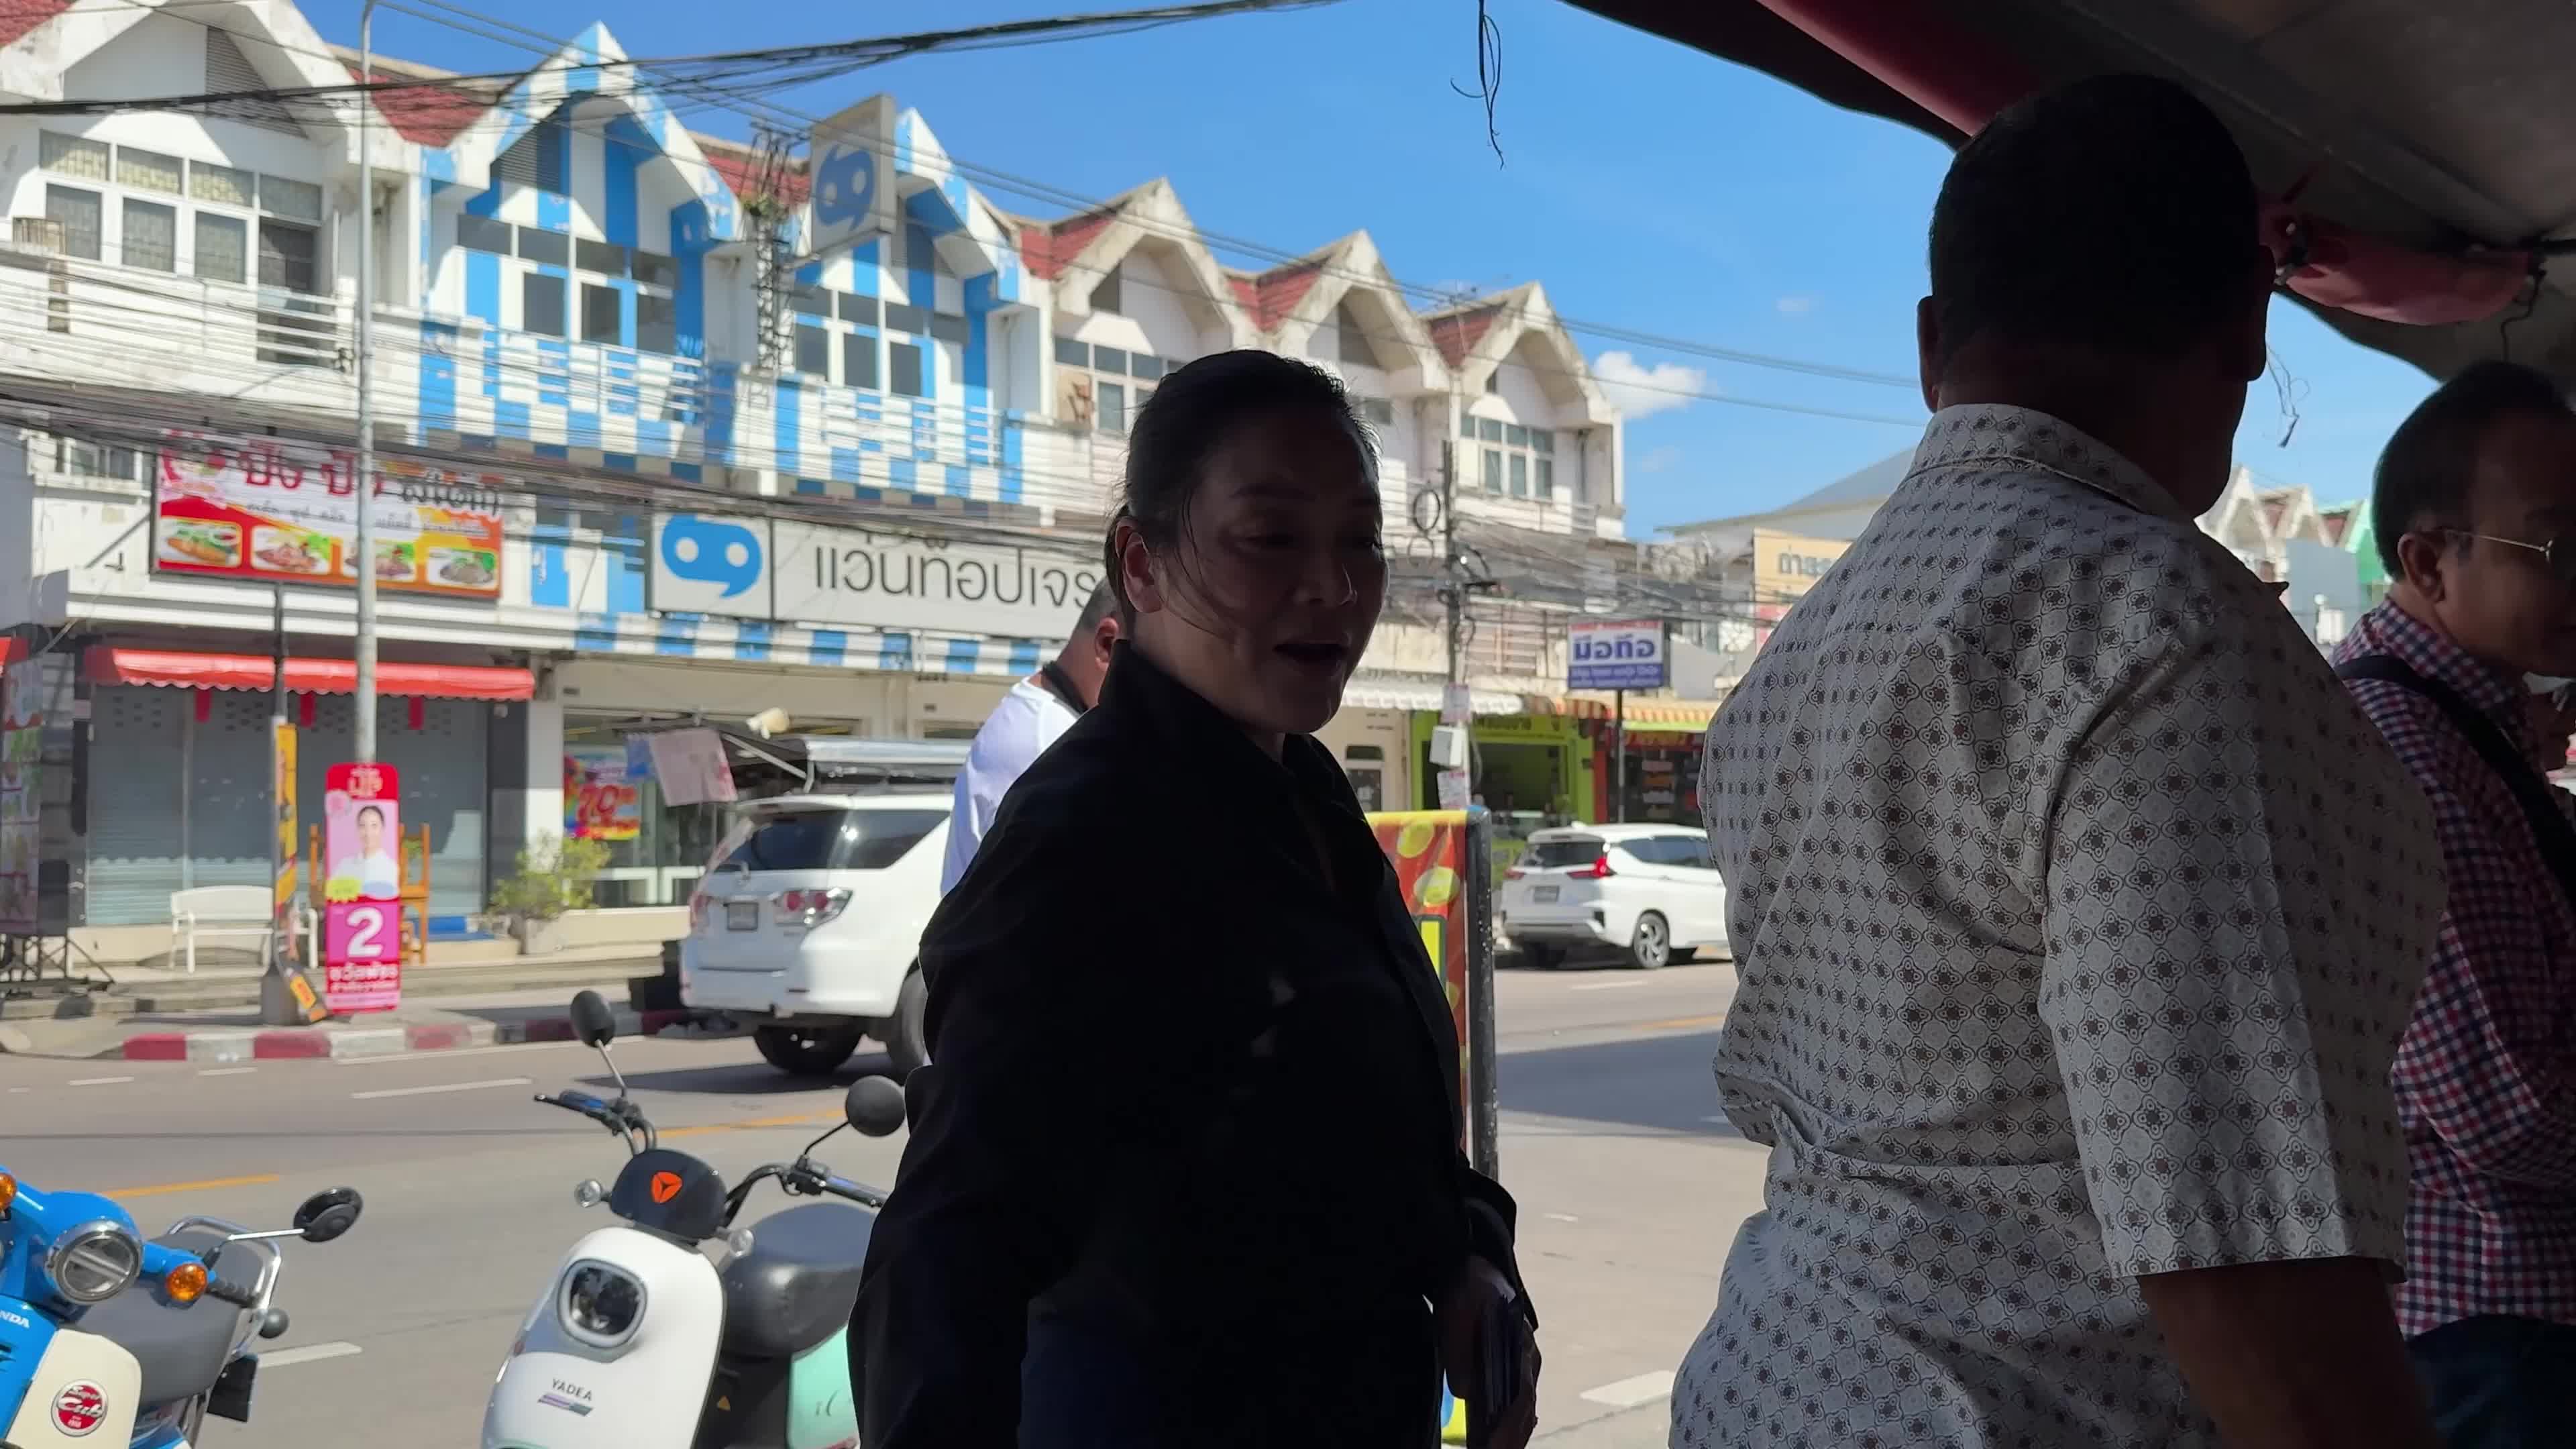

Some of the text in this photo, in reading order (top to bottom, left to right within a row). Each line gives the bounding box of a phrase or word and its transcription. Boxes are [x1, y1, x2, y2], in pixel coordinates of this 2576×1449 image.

[816, 531, 1096, 609] แว่นท็อปเจร
[347, 907, 384, 958] 2
[0, 1310, 30, 1328] NDA
[552, 1379, 592, 1401] YADEA
[58, 1395, 103, 1417] Cub
